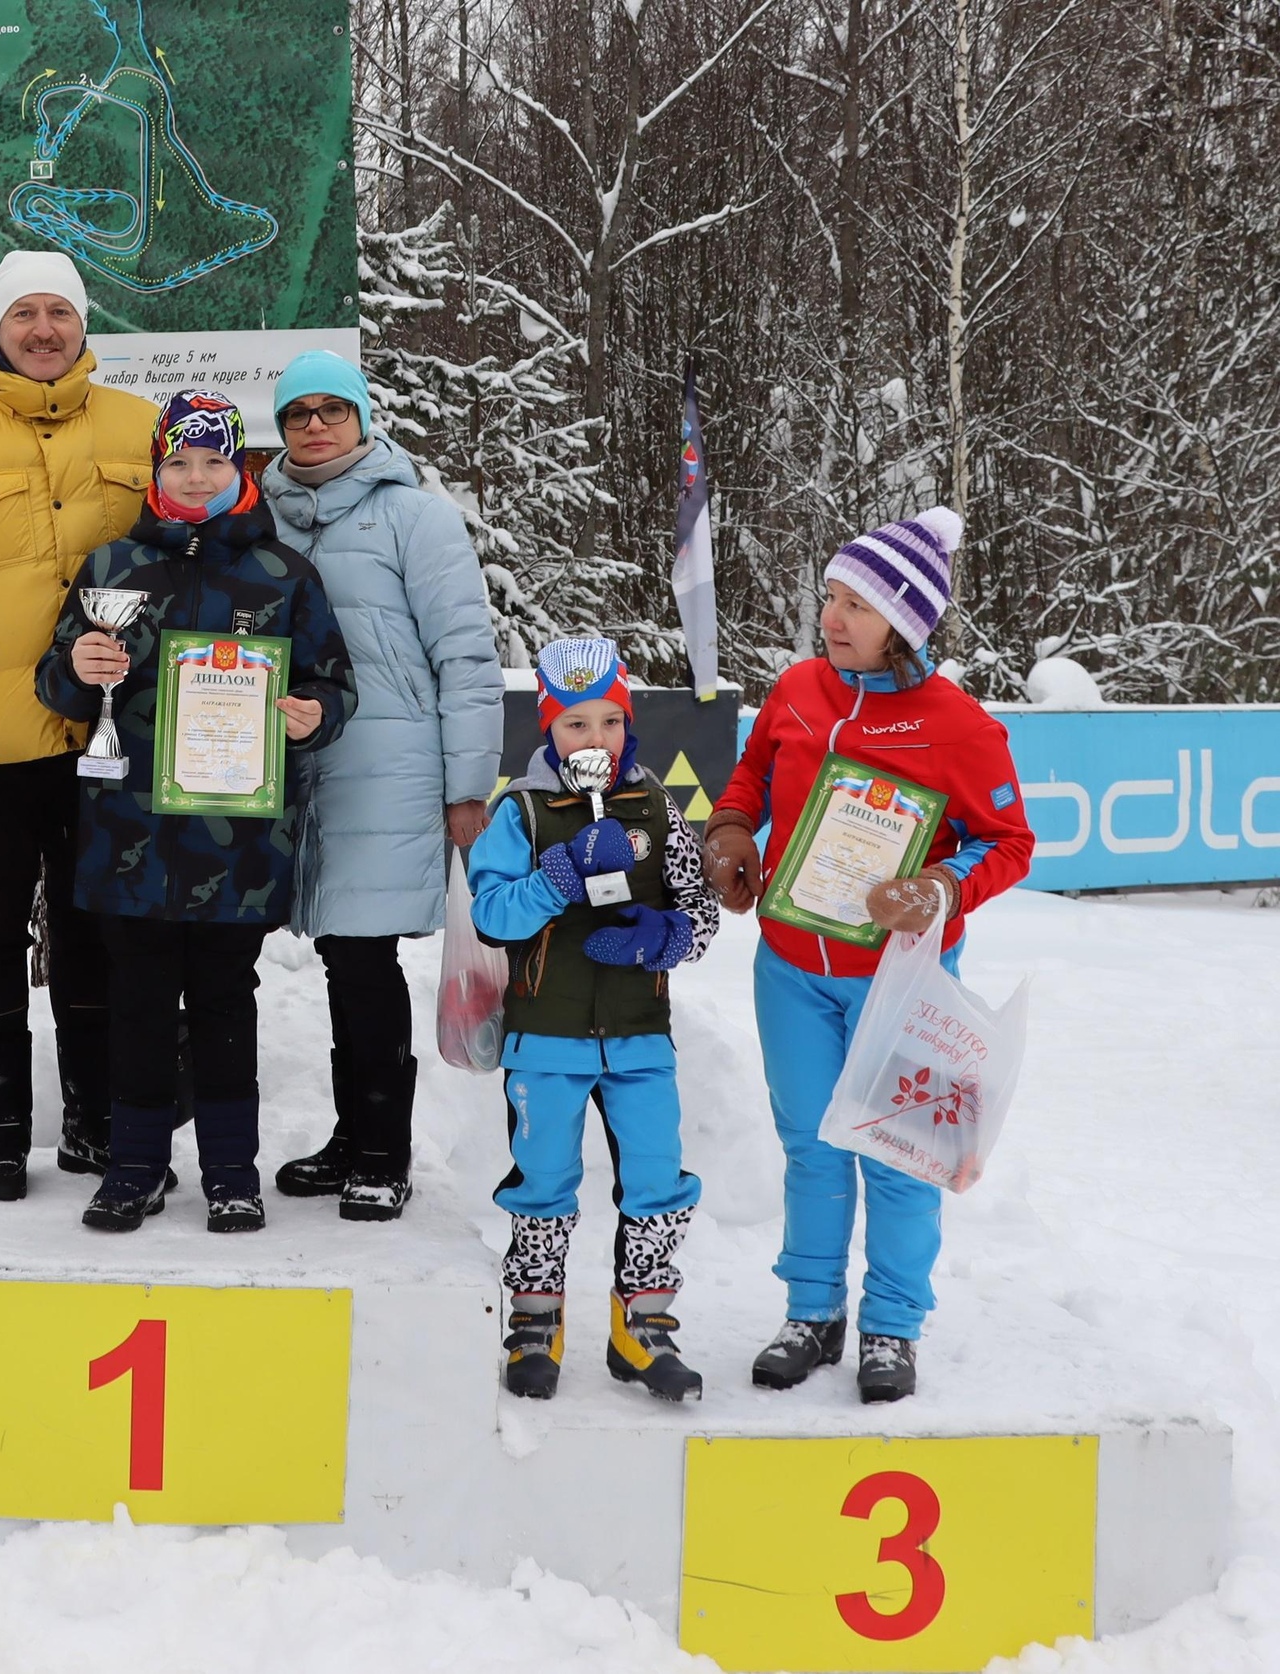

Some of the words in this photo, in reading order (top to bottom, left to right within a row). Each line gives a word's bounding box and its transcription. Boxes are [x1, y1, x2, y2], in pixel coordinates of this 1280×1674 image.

[79, 73, 87, 84] 2
[37, 166, 44, 175] 1
[152, 353, 180, 367] круг
[186, 350, 195, 363] 5
[200, 351, 217, 363] км
[104, 371, 138, 386] набор
[145, 370, 184, 383] высот
[191, 371, 205, 382] на
[212, 370, 247, 384] круге
[253, 368, 262, 381] 5
[191, 673, 256, 686] ДИПЛОМ
[838, 803, 903, 832] ДИПЛОМ
[584, 828, 599, 865] sport
[88, 1319, 167, 1491] 1
[835, 1471, 945, 1641] 3
